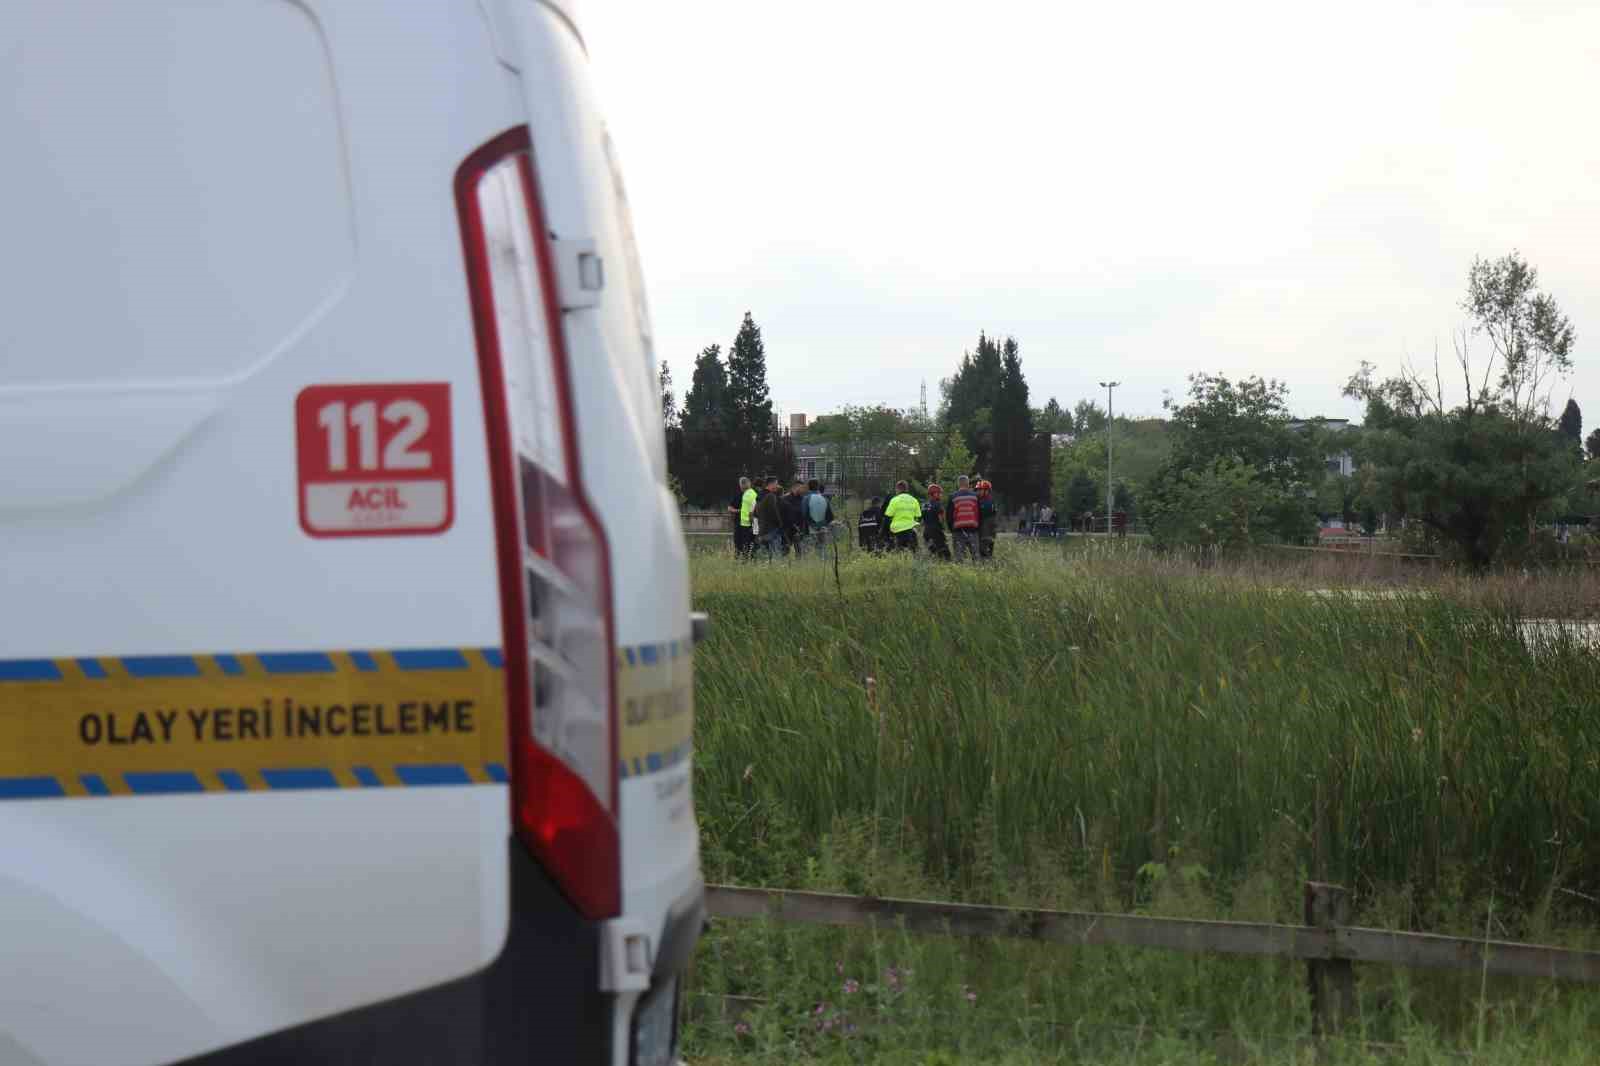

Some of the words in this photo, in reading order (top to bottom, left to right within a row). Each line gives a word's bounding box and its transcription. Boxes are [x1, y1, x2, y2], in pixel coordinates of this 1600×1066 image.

[317, 399, 432, 472] 112
[79, 708, 178, 746] OLAY
[188, 698, 272, 741] YERİ
[283, 697, 476, 738] İNCELEME
